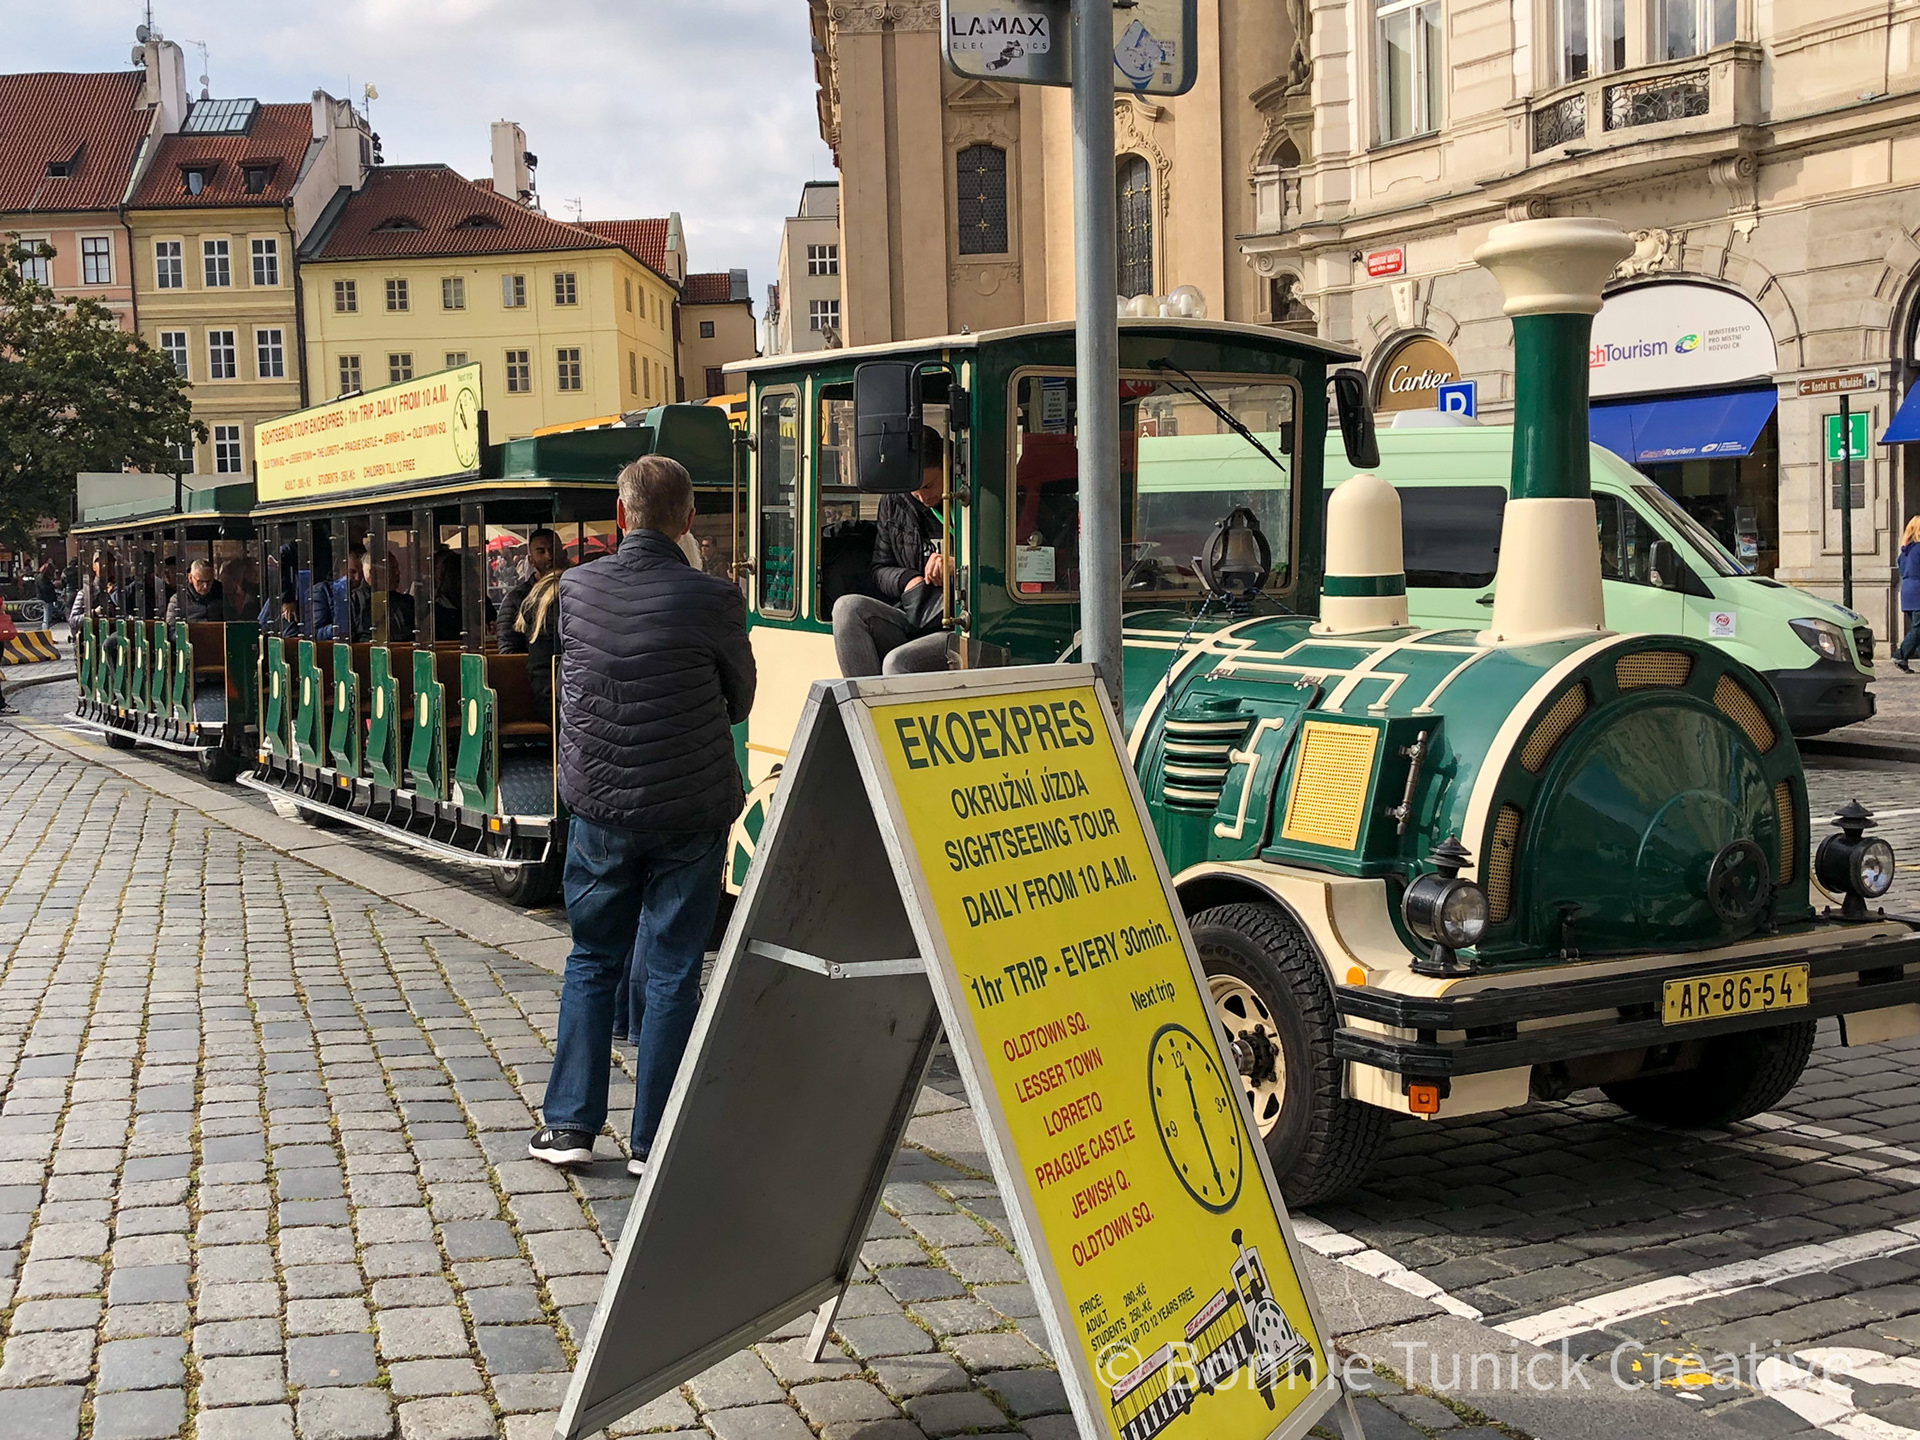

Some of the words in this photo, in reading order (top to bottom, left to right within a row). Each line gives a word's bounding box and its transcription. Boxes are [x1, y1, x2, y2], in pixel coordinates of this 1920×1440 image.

[951, 16, 1046, 37] LAMAX
[953, 42, 1047, 50] ELECICS
[1708, 325, 1751, 336] MINISTERSTVO
[1721, 333, 1742, 342] MÍSTNÍ
[1588, 339, 1668, 363] chTourism
[1708, 343, 1731, 351] ROZVOJ
[1389, 365, 1453, 393] Cartier
[1811, 380, 1828, 393] Kostel
[261, 424, 294, 446] SIGHTSEEING
[294, 419, 309, 438] TOUR
[309, 410, 344, 434] EKOEXPRES
[348, 407, 359, 425] 1hr
[377, 396, 399, 418] DAILY
[399, 390, 421, 413] FROM
[422, 388, 431, 407] 10
[432, 383, 449, 405] A.M.
[1445, 391, 1467, 414] P
[412, 427, 423, 440] OLD
[423, 423, 438, 437] TOWN
[1639, 447, 1697, 459] CzechTourism
[317, 471, 339, 486] STUDENTS
[363, 464, 386, 479] CHILDREN
[386, 461, 397, 474] TILL
[403, 458, 416, 472] FREE
[894, 699, 1095, 770] EKOEXPRES
[950, 766, 1038, 820] OKRUŽNÍ
[1040, 765, 1090, 804] JÍZDA
[944, 817, 1072, 873] SIGHTSEEING
[1069, 807, 1121, 842] TOUR
[961, 882, 1023, 928] DAILY
[1022, 868, 1079, 911] FROM
[1078, 864, 1101, 895] 10
[1101, 855, 1138, 889] A.M.
[970, 974, 1005, 1010] 1hr
[1003, 955, 1049, 998] TRIP
[1060, 931, 1120, 979] EVERY
[1119, 918, 1173, 958] 30min.
[1130, 983, 1158, 1012] Next
[1156, 978, 1176, 1006] trip
[1680, 971, 1793, 1019] AR-86-54
[1003, 1018, 1068, 1063] OLDTOWN
[1066, 1011, 1090, 1038] SQ.
[1172, 1050, 1187, 1070] 12
[1014, 1061, 1067, 1104] LESSER
[1065, 1047, 1104, 1084] TOWN
[1043, 1091, 1103, 1137] LORRETO
[1213, 1097, 1224, 1115] 3
[1169, 1120, 1180, 1138] 9
[1035, 1143, 1090, 1190] PRAGUE
[1088, 1119, 1136, 1160] CASTLE
[1071, 1174, 1118, 1220] JEWISH
[1115, 1169, 1131, 1191] Q.
[1072, 1213, 1134, 1267] OLDTOWN
[1131, 1201, 1155, 1231] SQ.
[1079, 1293, 1104, 1318] PRICE:
[1085, 1309, 1110, 1335] ADULT
[1090, 1317, 1127, 1352] STUDENTS
[1098, 1334, 1132, 1369] CHILDREN
[1130, 1327, 1141, 1344] UP
[1139, 1319, 1151, 1336] TO
[1149, 1315, 1159, 1330] 12
[1157, 1298, 1181, 1323] YEARS
[1178, 1286, 1196, 1306] FREE
